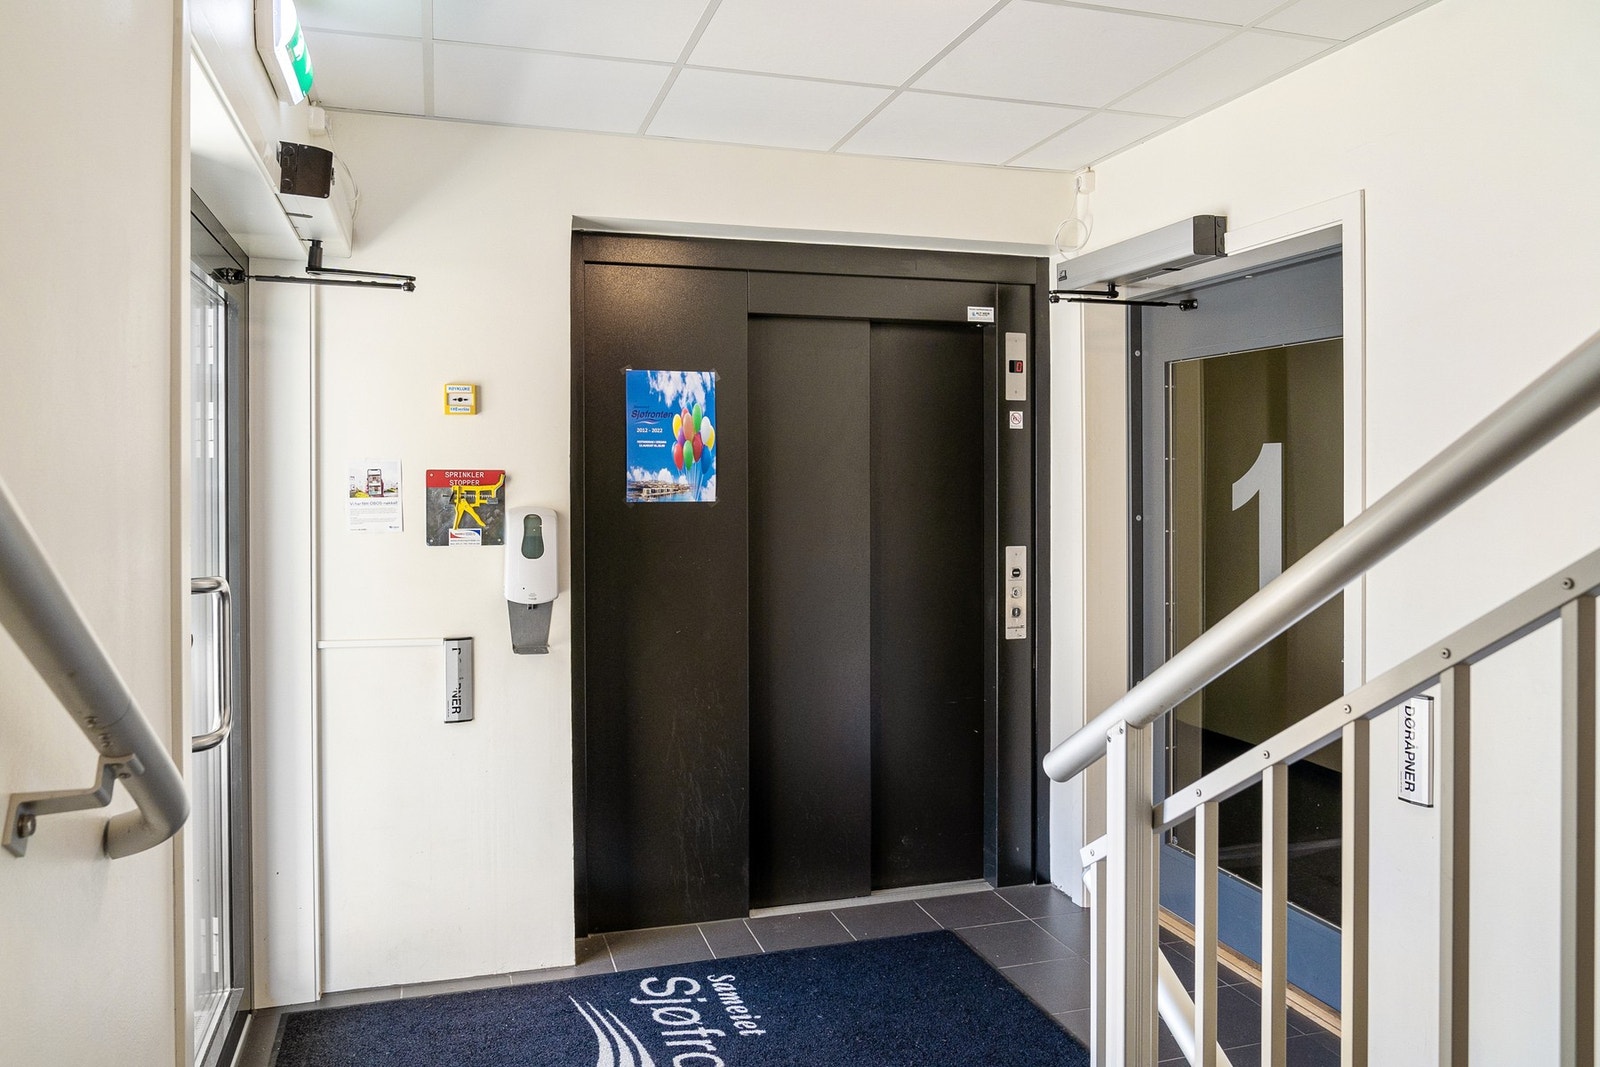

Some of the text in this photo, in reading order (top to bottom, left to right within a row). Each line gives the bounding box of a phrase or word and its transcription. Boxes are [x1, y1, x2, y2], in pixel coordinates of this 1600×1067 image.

[632, 410, 673, 419] Sjøfronten
[445, 471, 485, 479] SPRINKLER
[1232, 442, 1282, 590] 1
[1404, 705, 1419, 793] DØRÅPNER
[707, 973, 767, 1037] Sameiet
